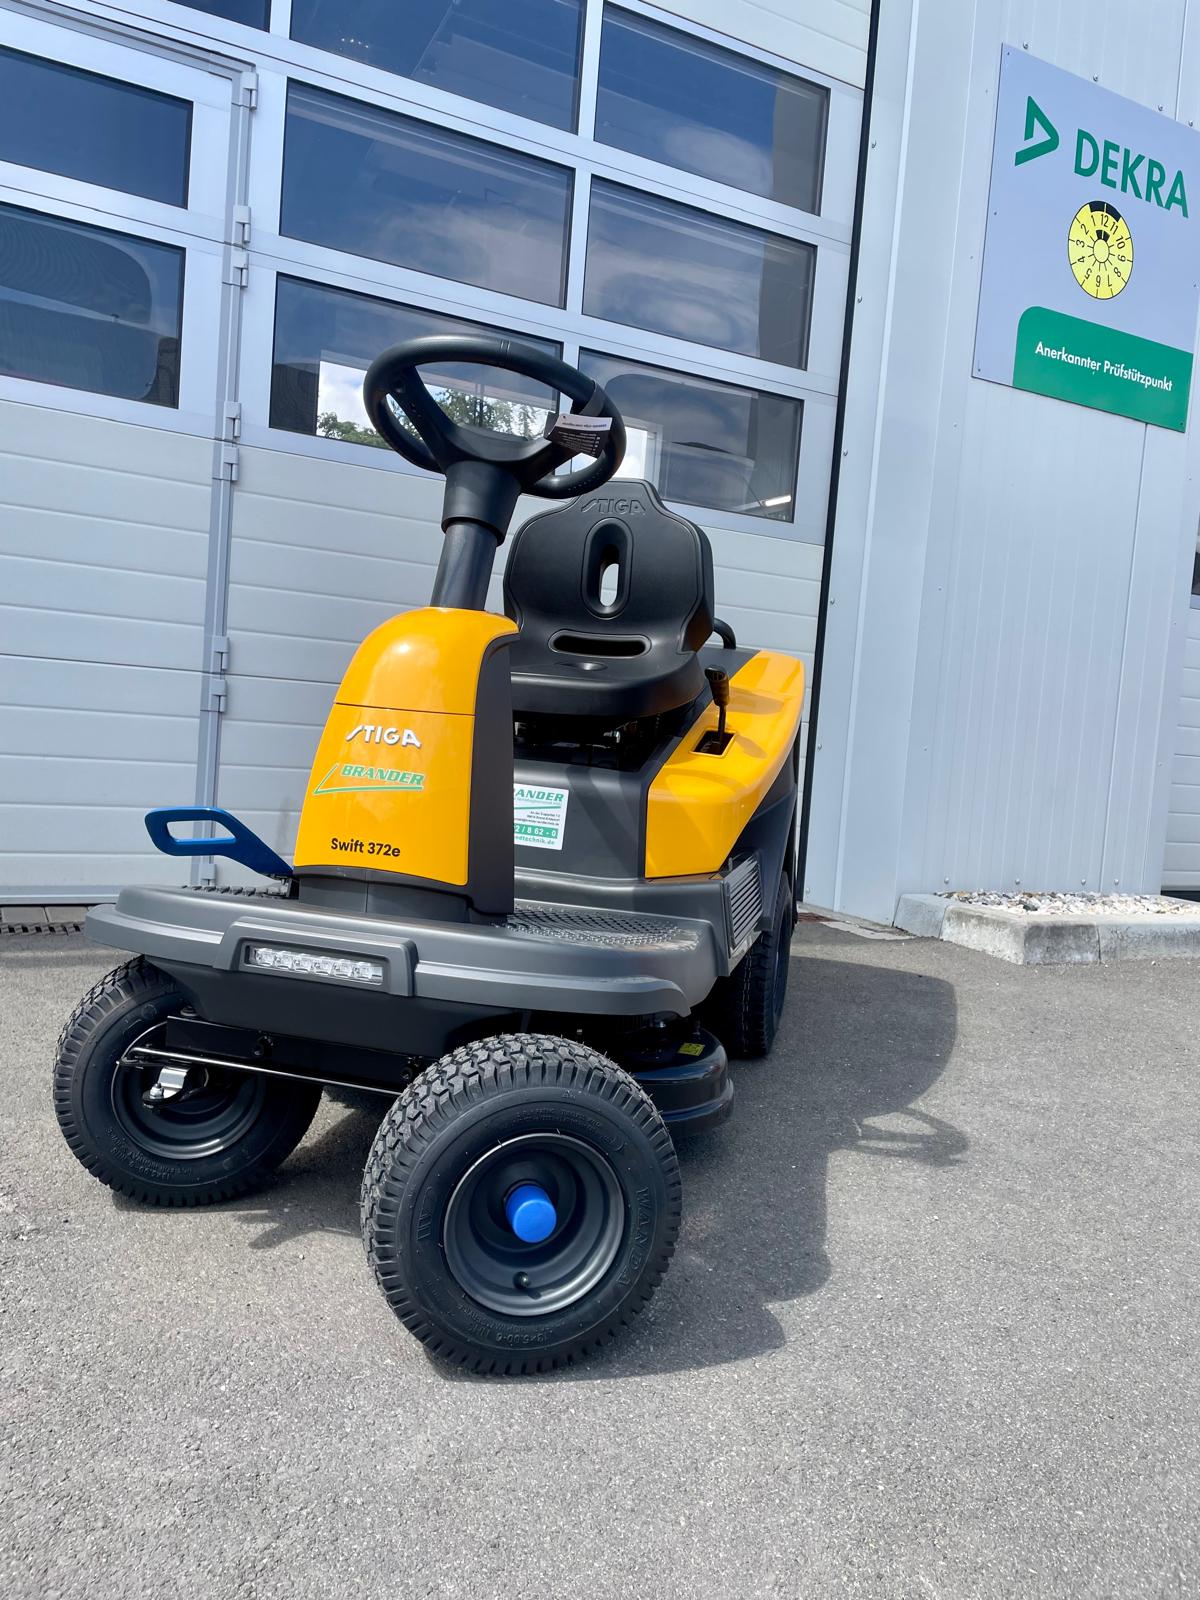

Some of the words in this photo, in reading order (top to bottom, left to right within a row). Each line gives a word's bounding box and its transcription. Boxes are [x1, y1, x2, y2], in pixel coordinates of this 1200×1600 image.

[1074, 128, 1189, 219] DEKRA
[1090, 214, 1096, 227] 1
[1100, 213, 1109, 228] 12
[1080, 223, 1090, 235] 2
[1109, 221, 1119, 235] 11
[1075, 239, 1086, 248] 3
[1115, 235, 1126, 250] 10
[1077, 255, 1086, 263] 4
[1117, 254, 1127, 263] 9
[1084, 267, 1093, 280] 5
[1113, 266, 1122, 278] 8
[1095, 274, 1102, 288] 6
[1107, 274, 1113, 287] 7
[1035, 341, 1101, 371] Anerkannter
[1103, 360, 1173, 391] Prüfstützpunkt
[581, 498, 646, 516] STIGA
[346, 725, 422, 749] STIGA
[341, 764, 425, 786] BRANDER
[514, 788, 564, 802] ANDER
[330, 837, 364, 853] Swift
[367, 841, 401, 857] 372e
